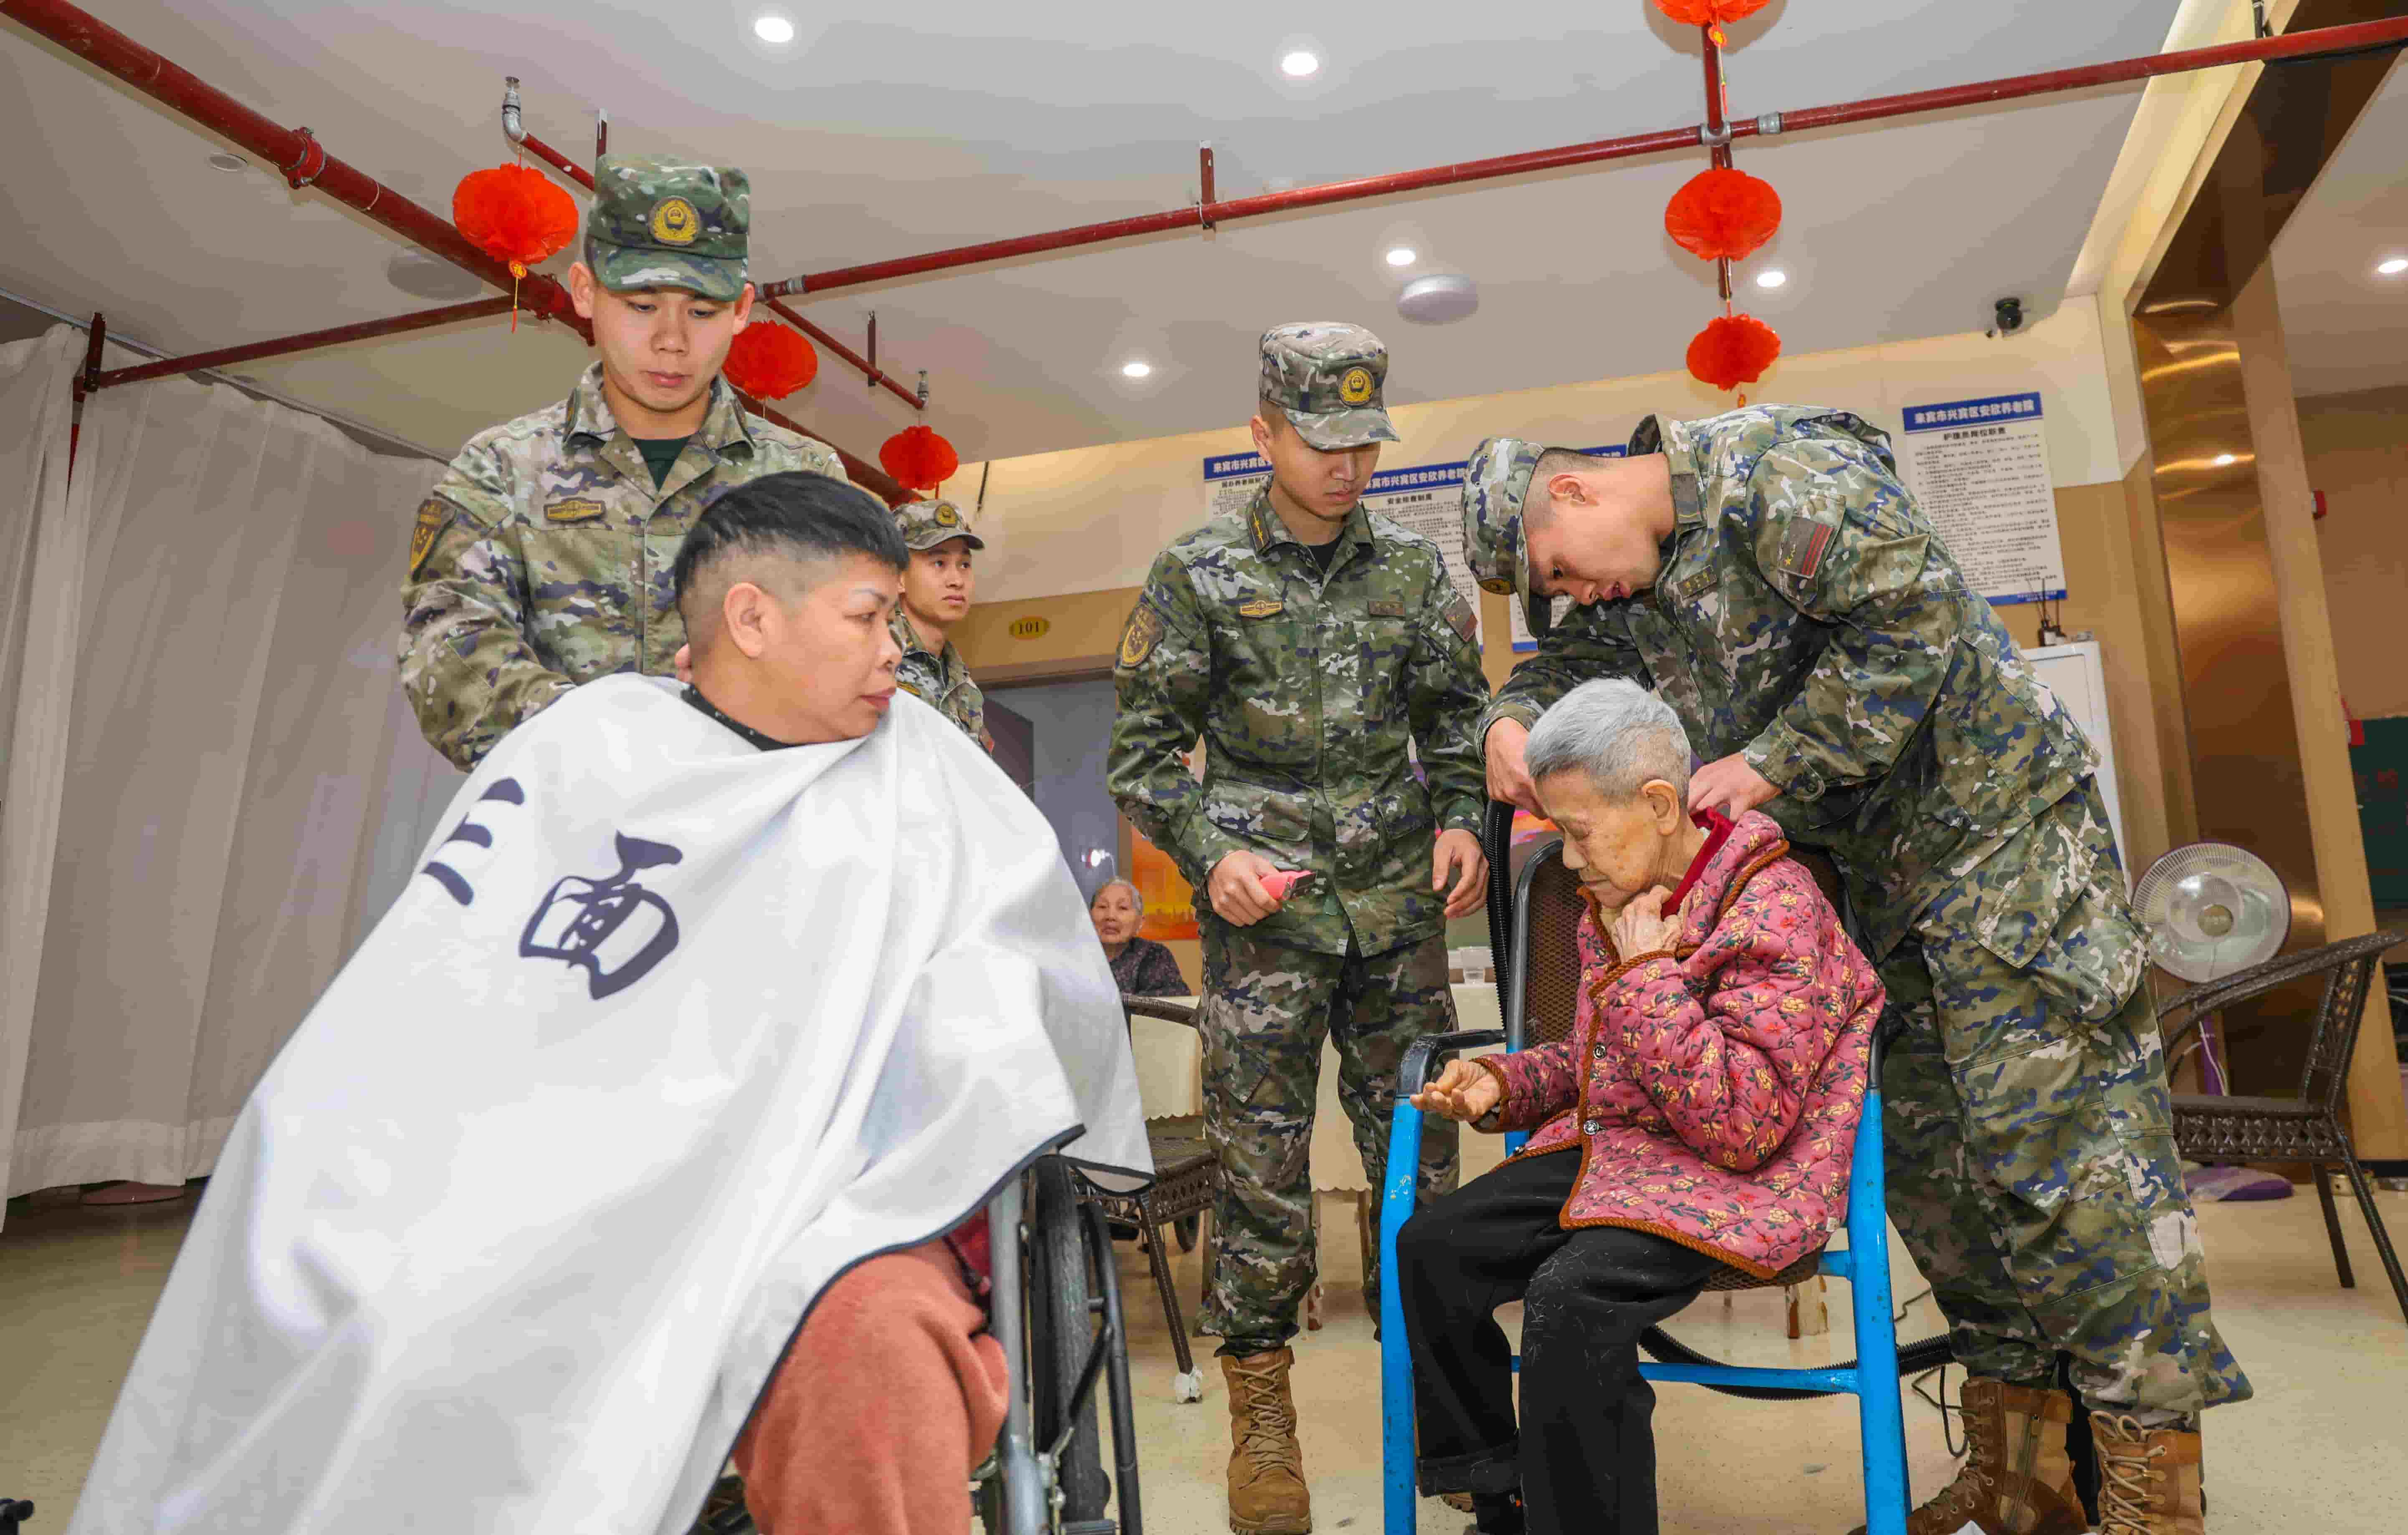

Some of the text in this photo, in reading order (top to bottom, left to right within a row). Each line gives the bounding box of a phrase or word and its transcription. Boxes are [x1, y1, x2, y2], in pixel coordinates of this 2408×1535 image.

[1213, 457, 1272, 474] 来宾市兴宾区
[1369, 468, 1467, 488] 宾市兴宾区安欣养老院
[1019, 621, 1039, 635] 101
